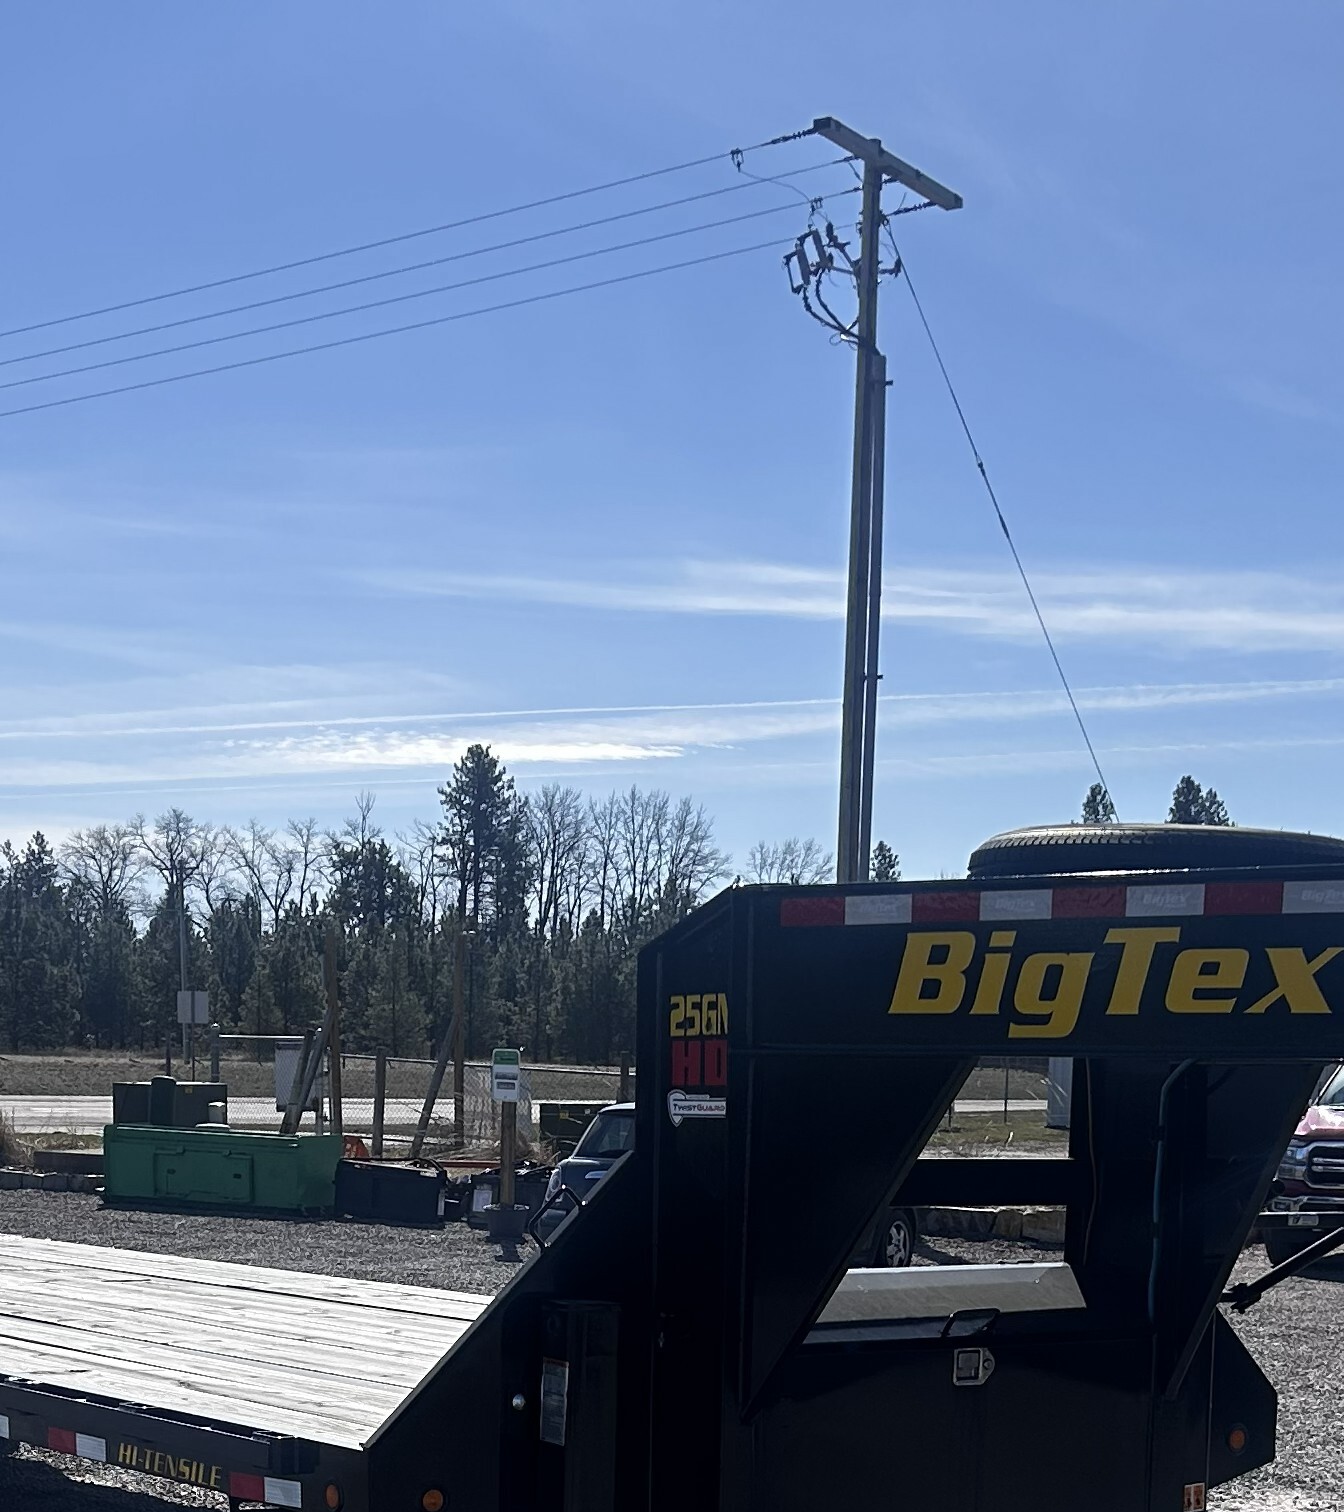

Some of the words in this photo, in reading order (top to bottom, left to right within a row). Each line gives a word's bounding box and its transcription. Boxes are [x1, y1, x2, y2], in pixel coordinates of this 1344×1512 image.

[669, 992, 729, 1037] 25GN
[671, 1039, 728, 1087] HD
[118, 1442, 223, 1489] HI-TENSILE
